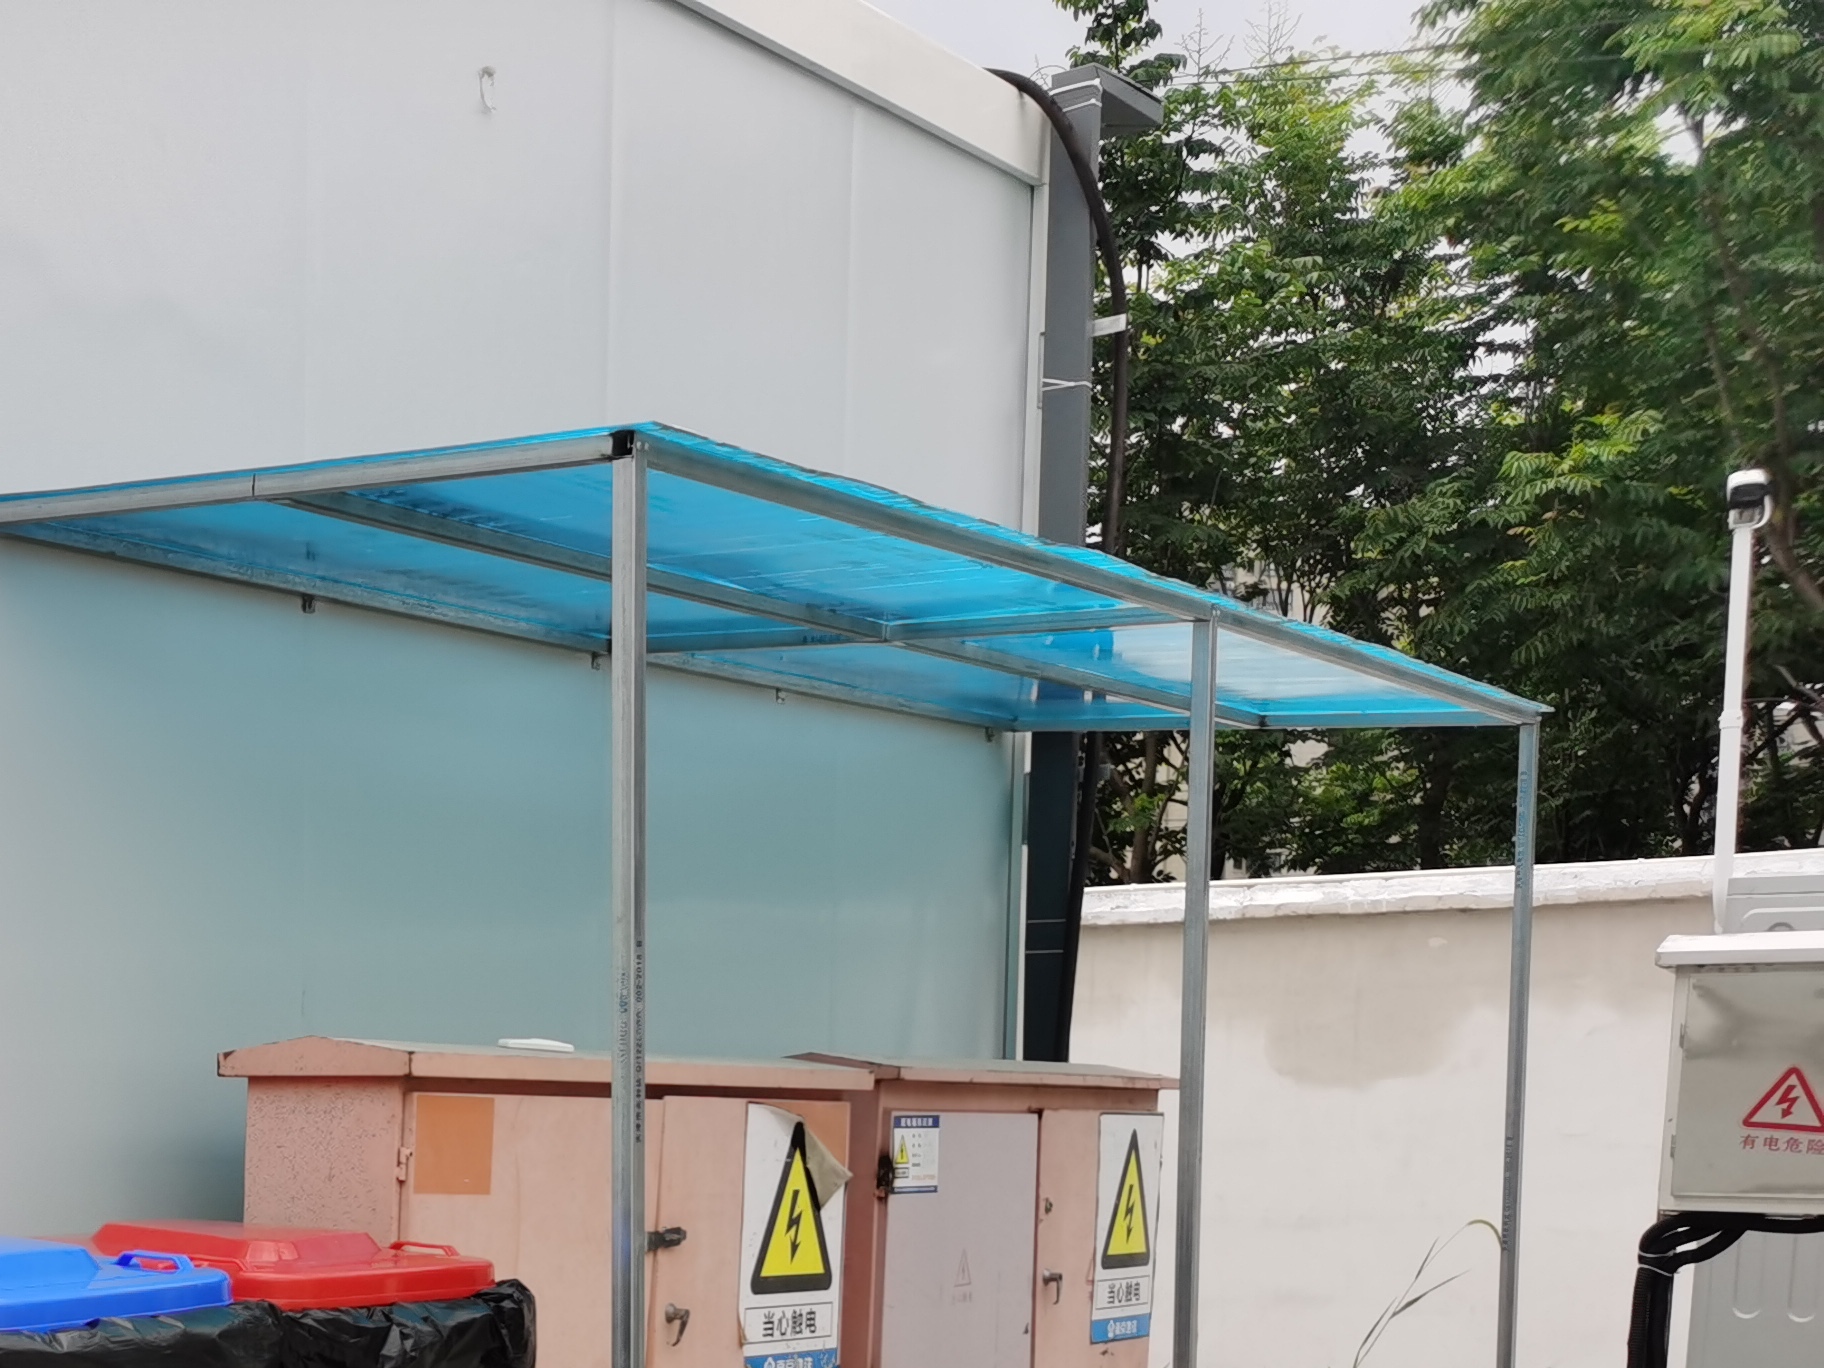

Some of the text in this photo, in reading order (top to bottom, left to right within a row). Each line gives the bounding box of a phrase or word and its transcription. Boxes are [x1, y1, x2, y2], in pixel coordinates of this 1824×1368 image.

[1739, 1133, 1824, 1155] 有电危险
[762, 1308, 817, 1338] 当心触电
